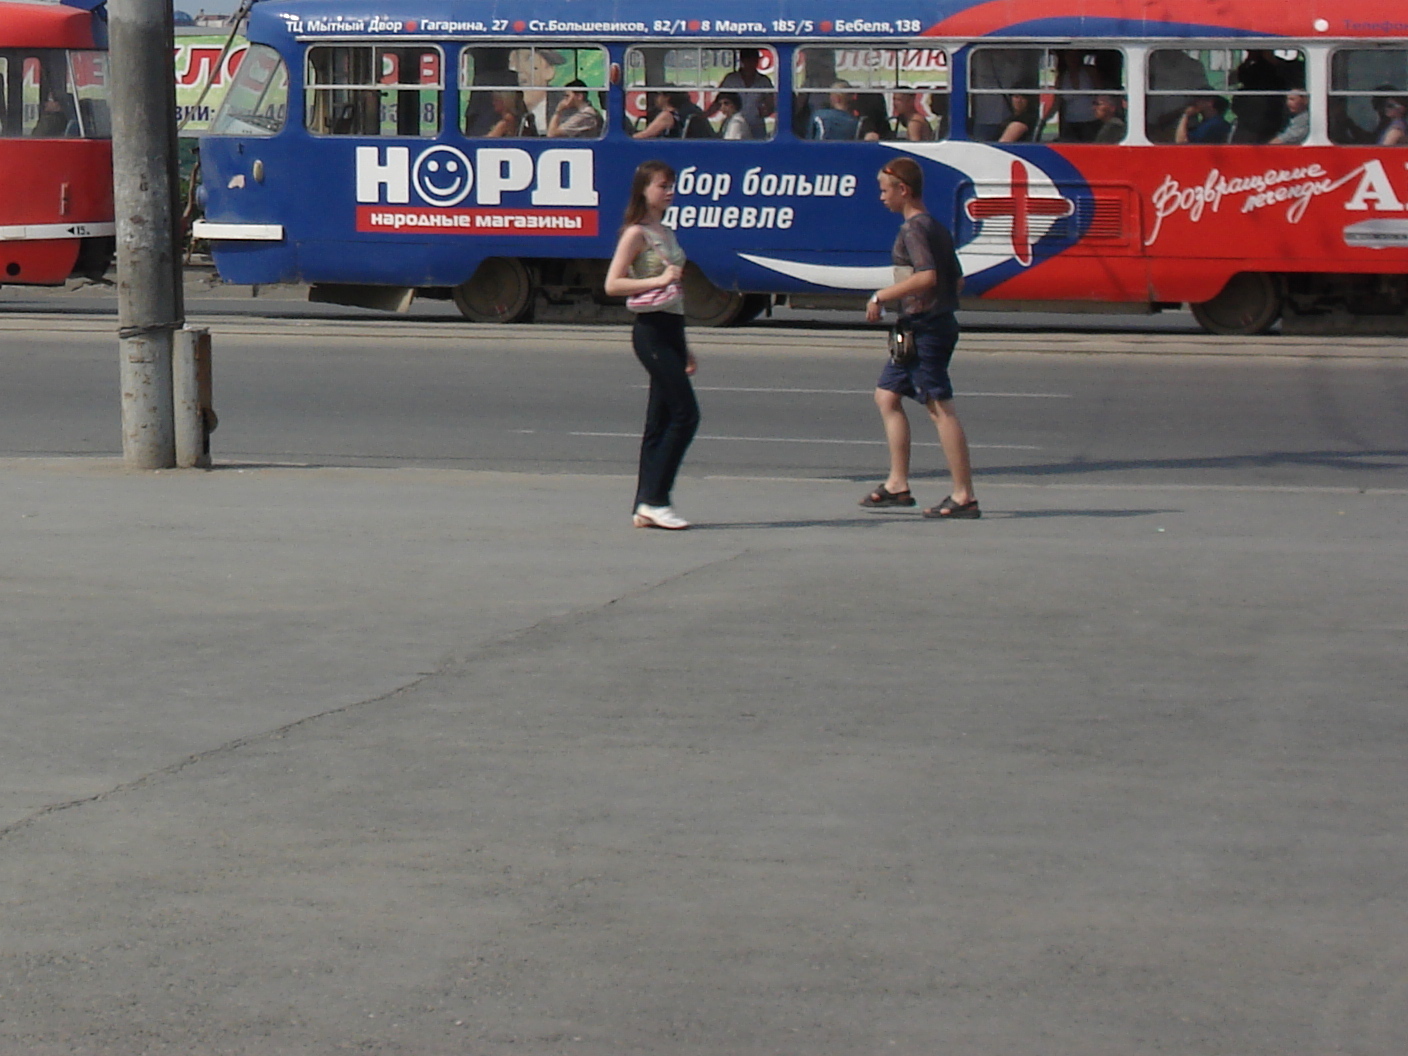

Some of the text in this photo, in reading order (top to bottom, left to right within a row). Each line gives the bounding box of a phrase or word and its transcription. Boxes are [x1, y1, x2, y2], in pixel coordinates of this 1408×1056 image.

[286, 19, 402, 34] ТЦ Мытный Двор
[420, 19, 508, 33] Гагарина, 27
[653, 20, 686, 35] 82/1
[701, 20, 814, 35] 8 Марта, 185/5
[835, 20, 921, 34] Бебеля, 138
[675, 165, 857, 201] бор больше
[1144, 163, 1327, 246] Возвращение
[370, 212, 582, 230] народные магазины
[660, 204, 794, 231] дешевле
